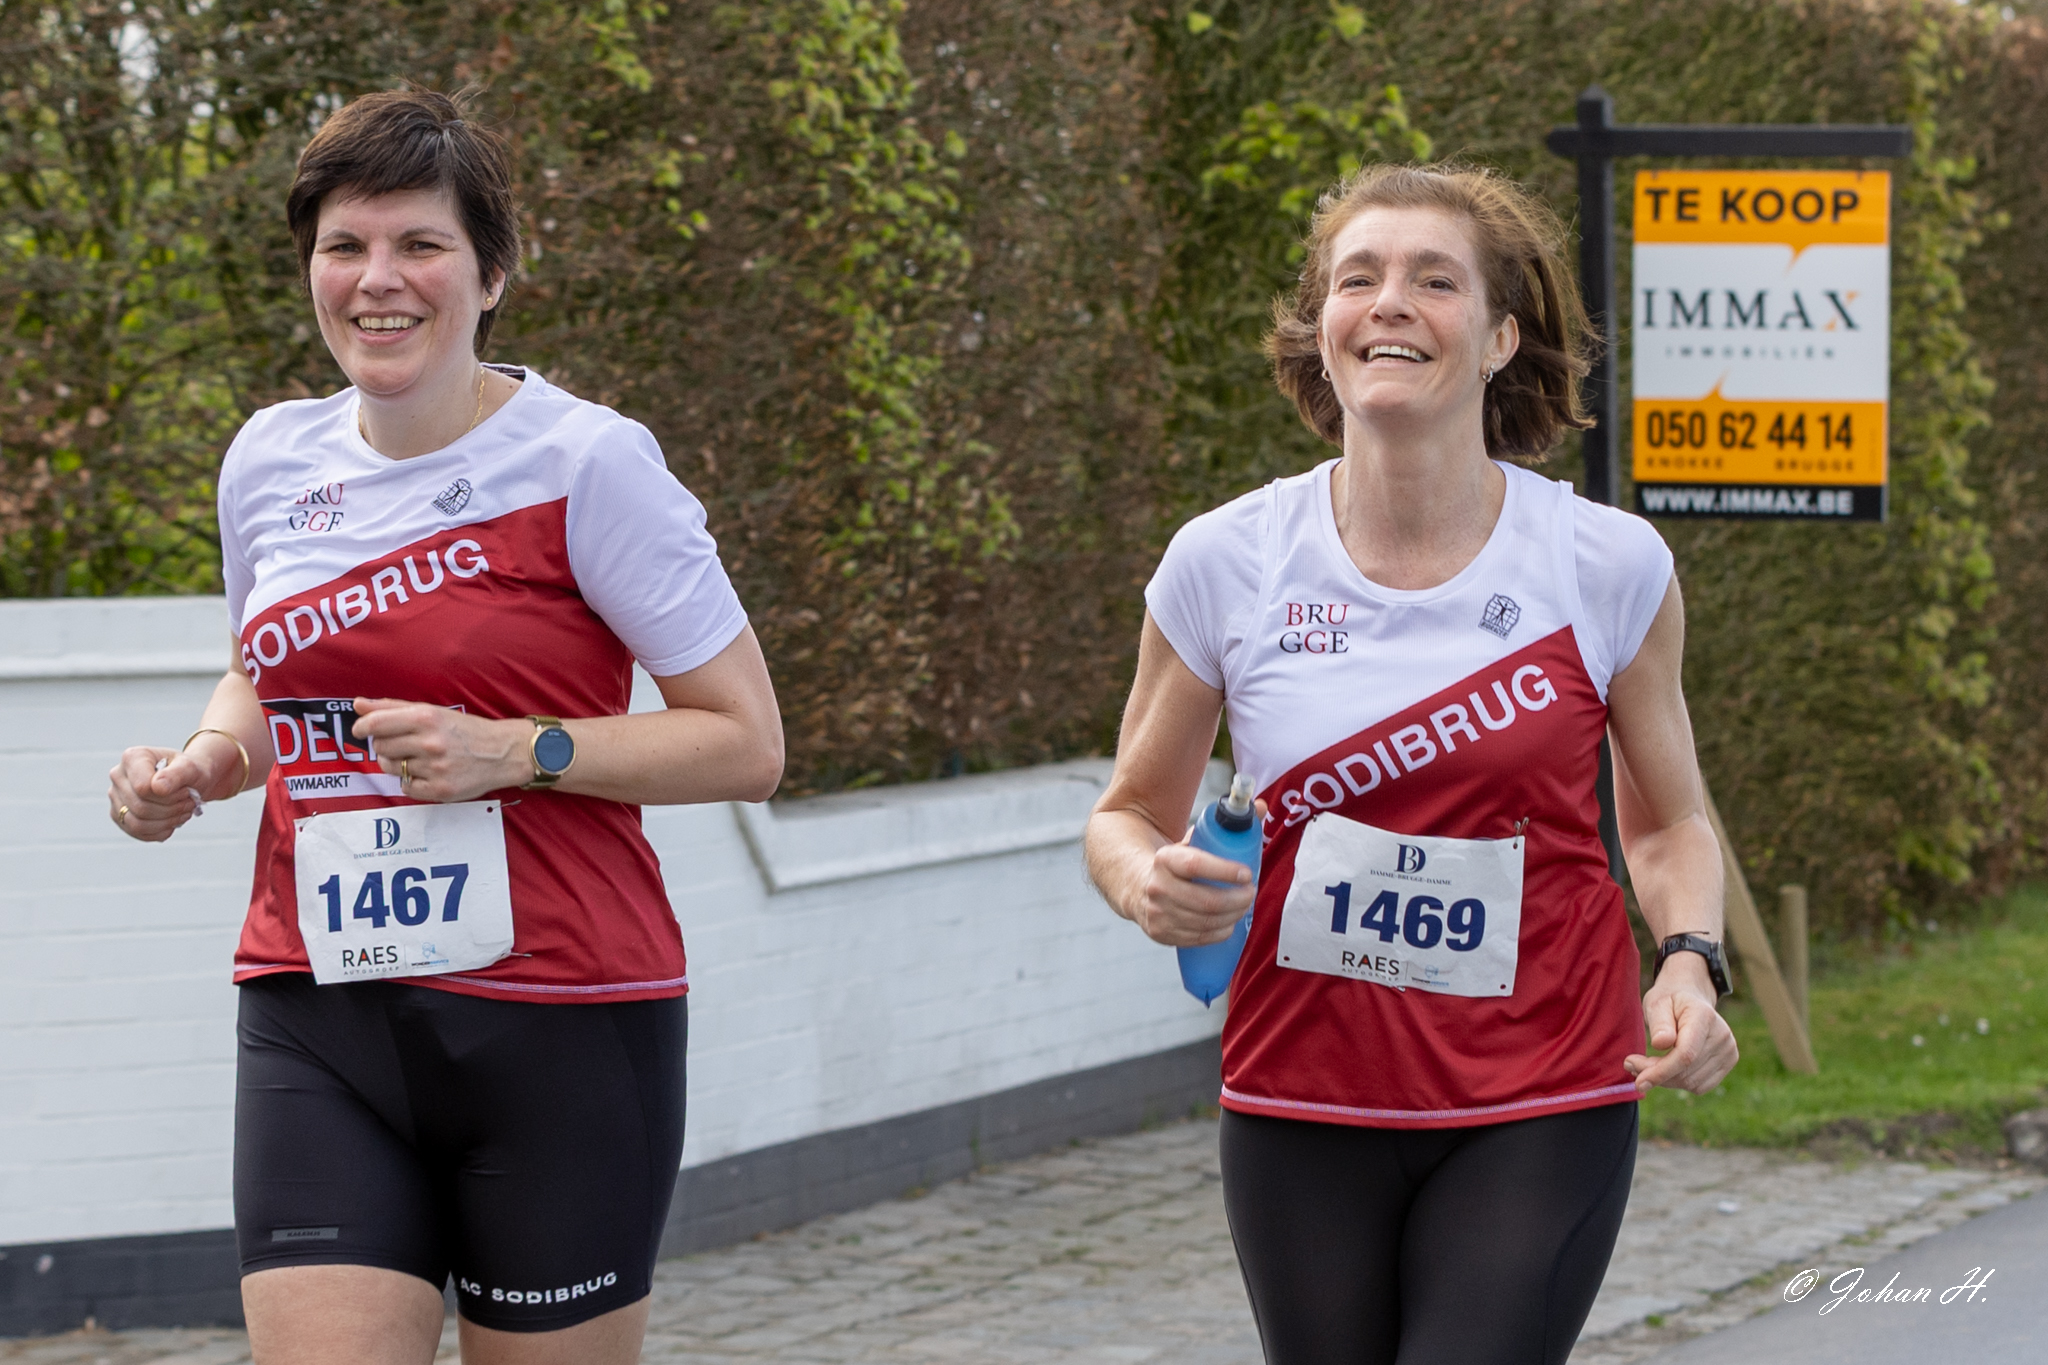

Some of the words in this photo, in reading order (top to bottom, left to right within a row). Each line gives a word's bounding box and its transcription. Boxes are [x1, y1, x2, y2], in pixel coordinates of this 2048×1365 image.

[1644, 188, 1700, 221] TE
[1720, 188, 1860, 223] KOOP
[1641, 288, 1860, 330] IMMAX
[1647, 410, 1707, 449] 050
[1719, 411, 1757, 450] 62
[1767, 412, 1807, 450] 44
[1818, 413, 1853, 452] 14
[1641, 488, 1854, 516] WWW.IMMAX.BE
[241, 539, 490, 686] SODIBRUG
[1284, 602, 1350, 627] BRU
[1279, 630, 1350, 654] GGE
[1281, 663, 1559, 828] SODIBRUG
[318, 863, 470, 933] 1467
[1324, 881, 1486, 952] 1469
[342, 945, 399, 968] RAES
[1341, 950, 1400, 976] RAES
[460, 1277, 482, 1296] AC
[491, 1271, 618, 1305] SODIBRUG
